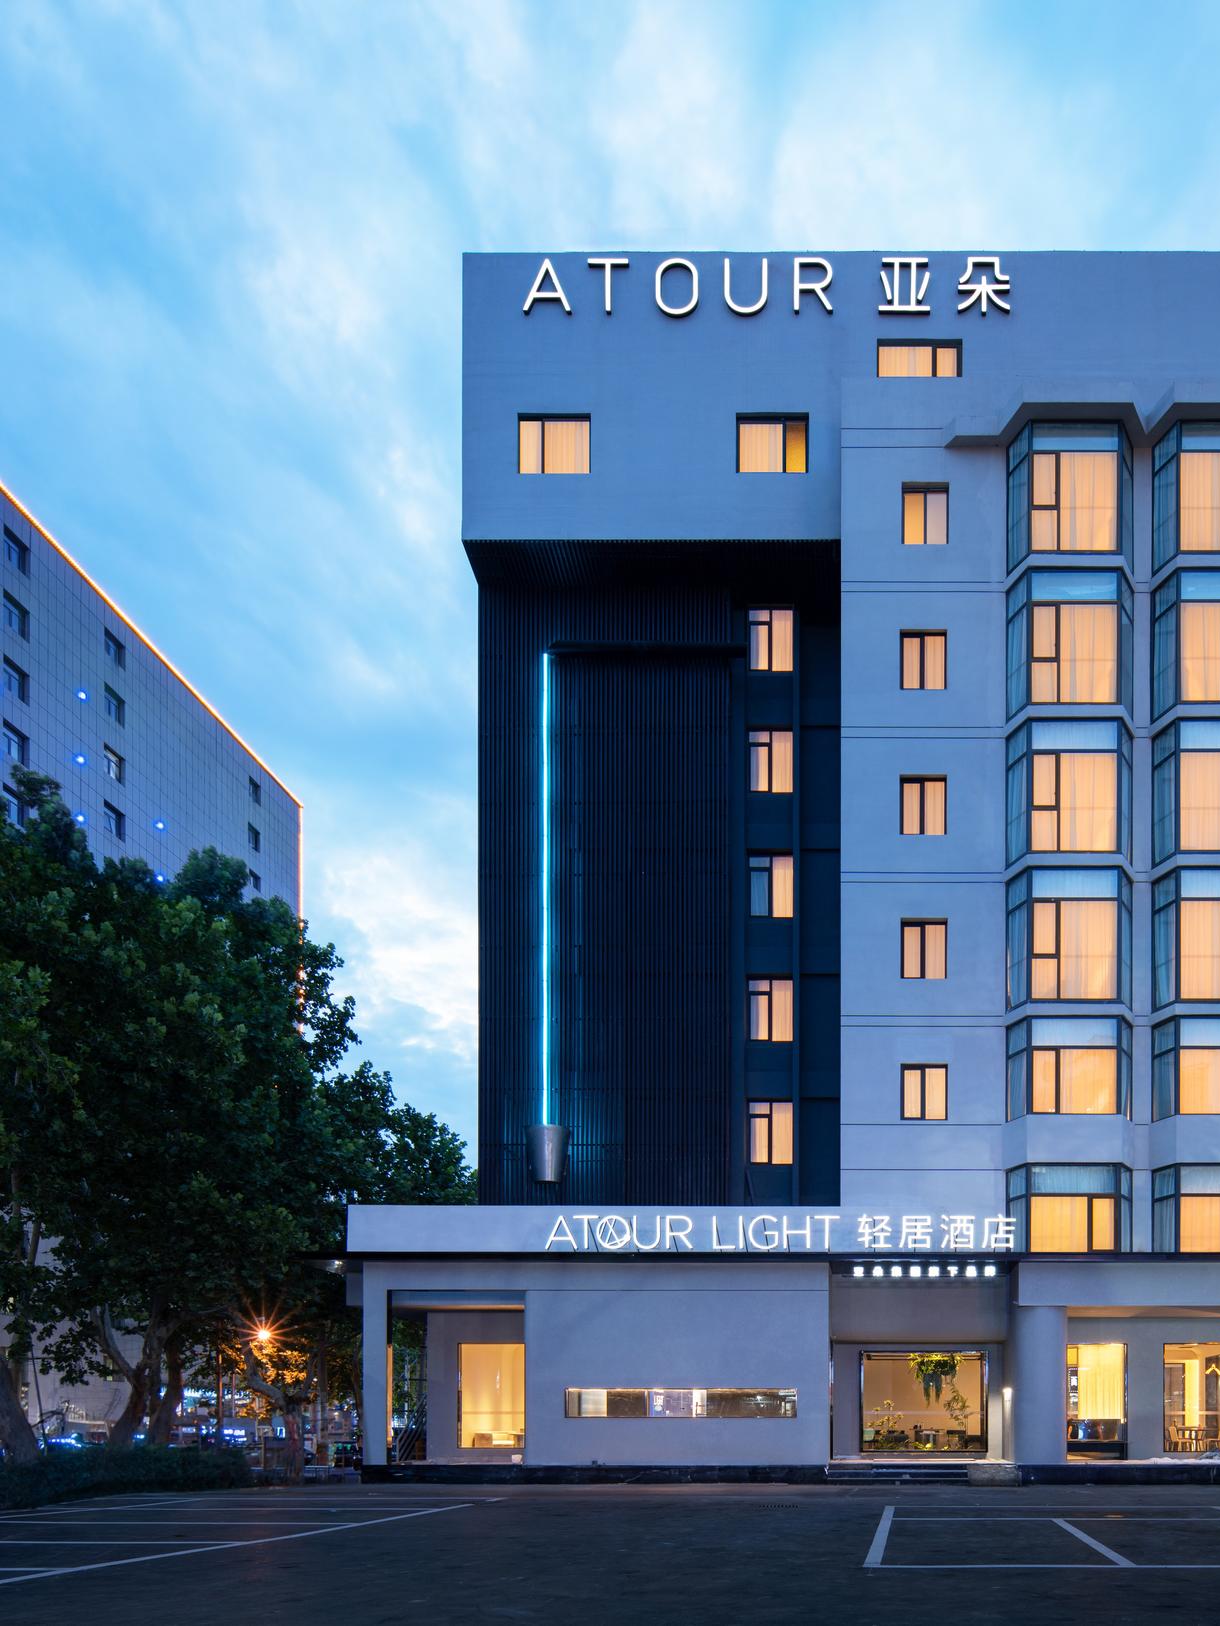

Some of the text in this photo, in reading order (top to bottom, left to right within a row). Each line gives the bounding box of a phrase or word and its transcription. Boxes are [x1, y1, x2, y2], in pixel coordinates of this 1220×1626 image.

[522, 255, 1012, 315] ATOUR 亚朵
[545, 1213, 1017, 1250] ATOUR LIGHT 轻居酒店
